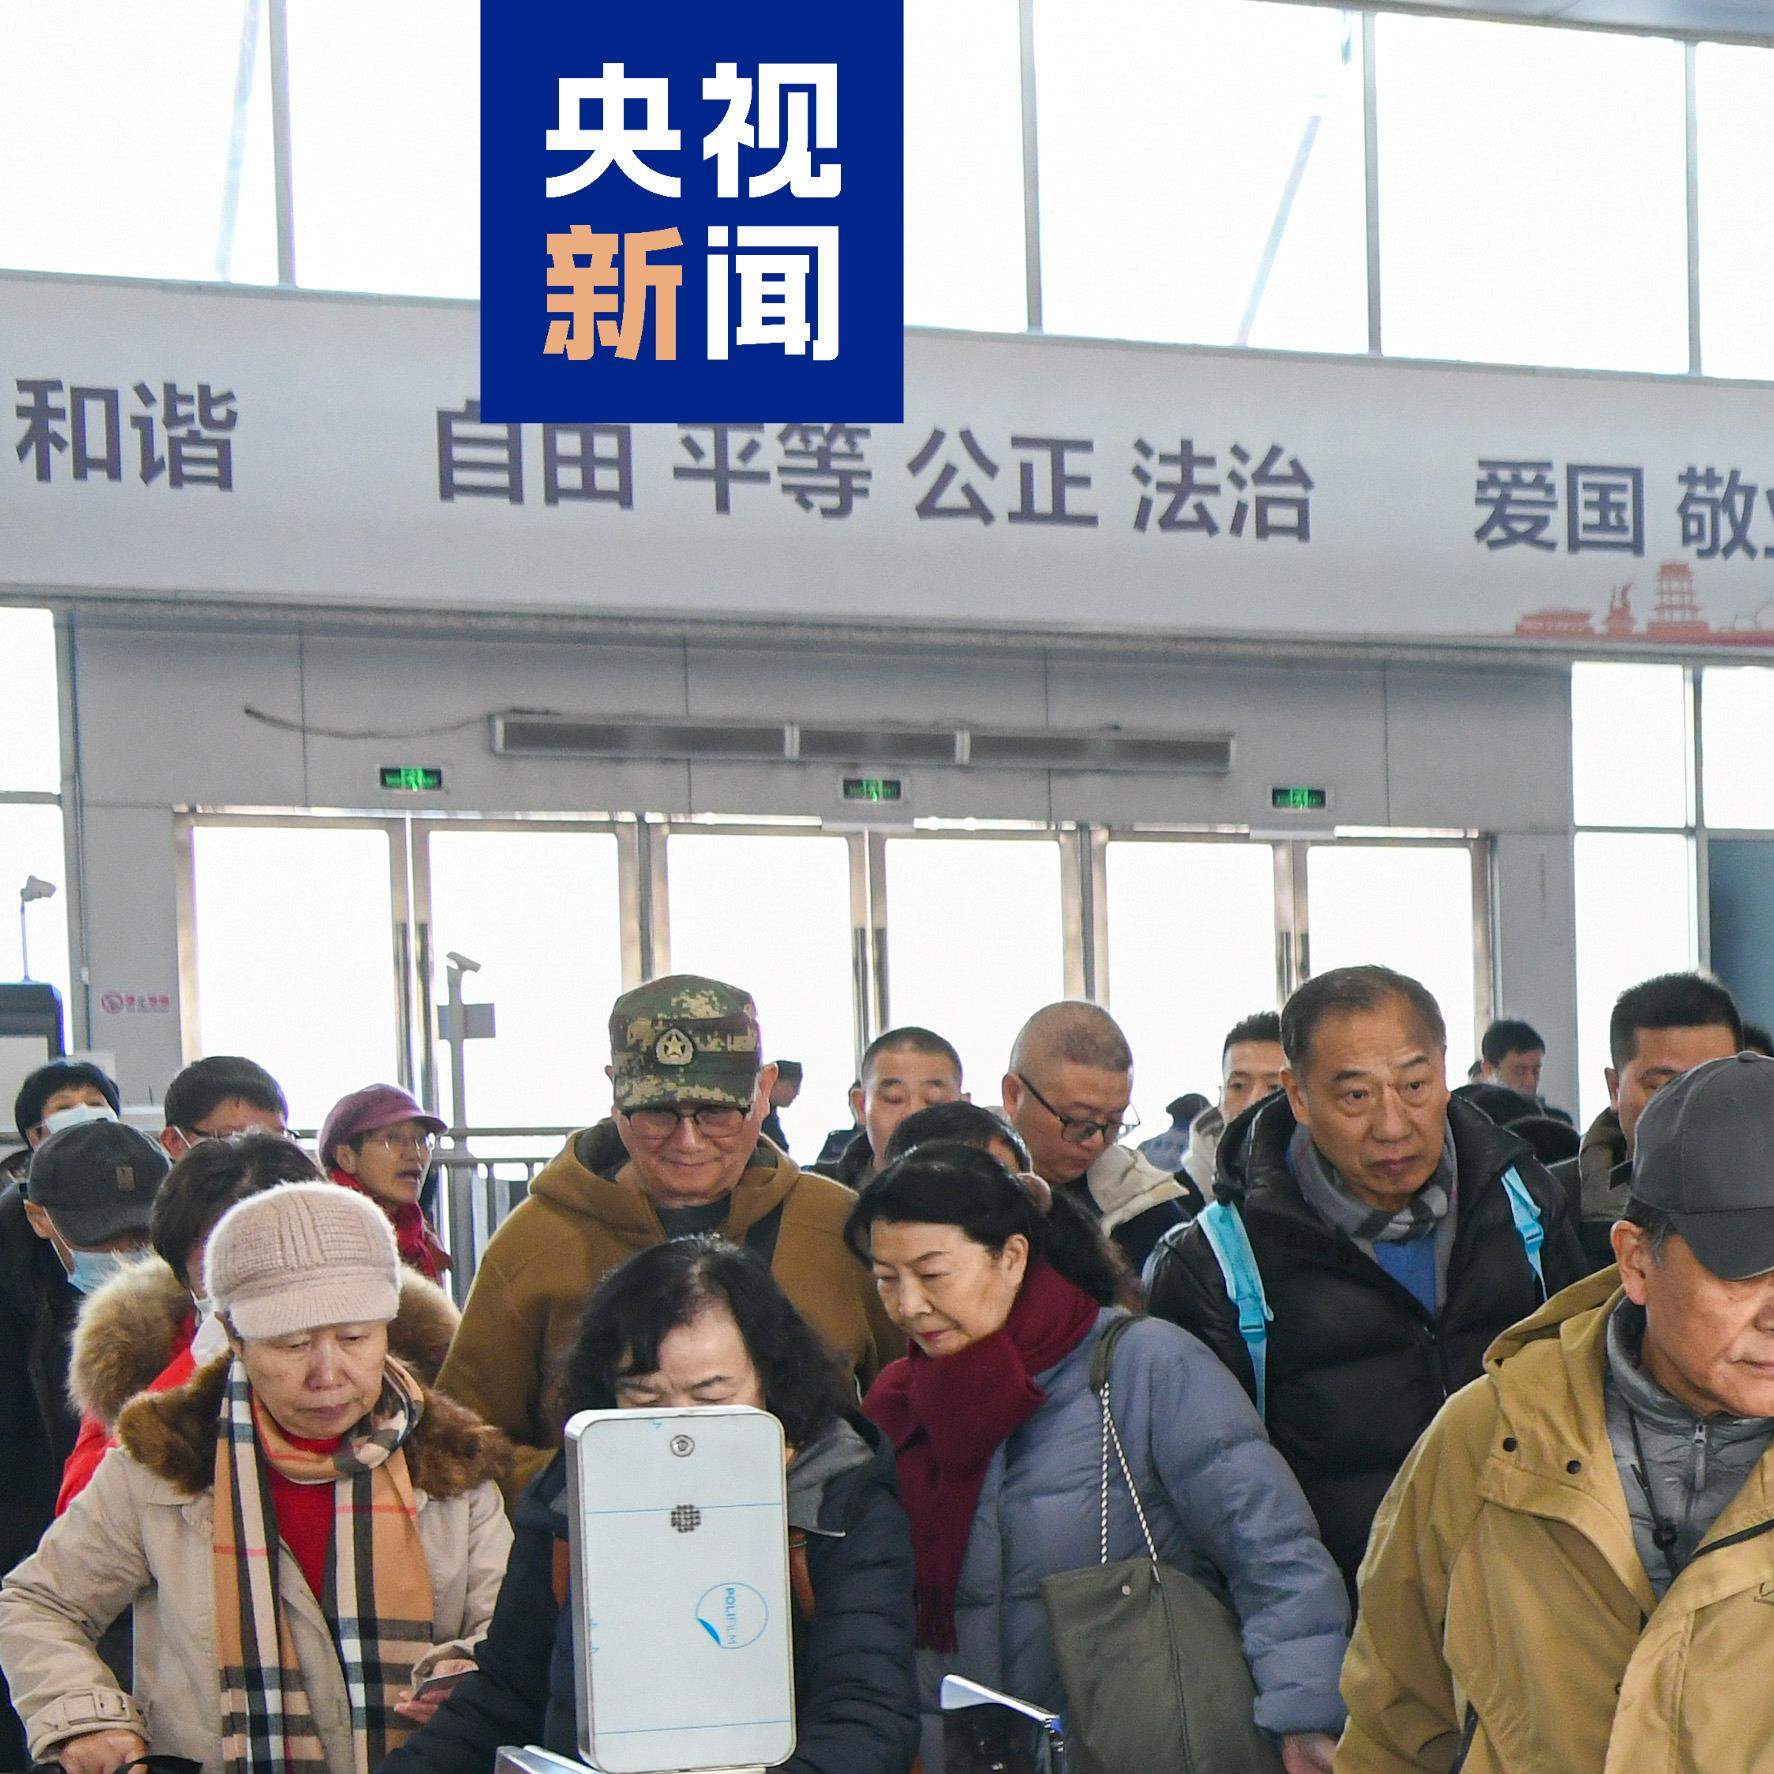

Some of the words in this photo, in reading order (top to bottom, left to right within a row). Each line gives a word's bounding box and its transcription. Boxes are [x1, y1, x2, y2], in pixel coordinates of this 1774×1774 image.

[15, 376, 239, 493] 和谐
[437, 399, 635, 511] 自由
[673, 422, 874, 521] 平等
[907, 428, 1100, 528] 公正
[1131, 437, 1314, 542] 法治
[1474, 457, 1647, 556] 爱国
